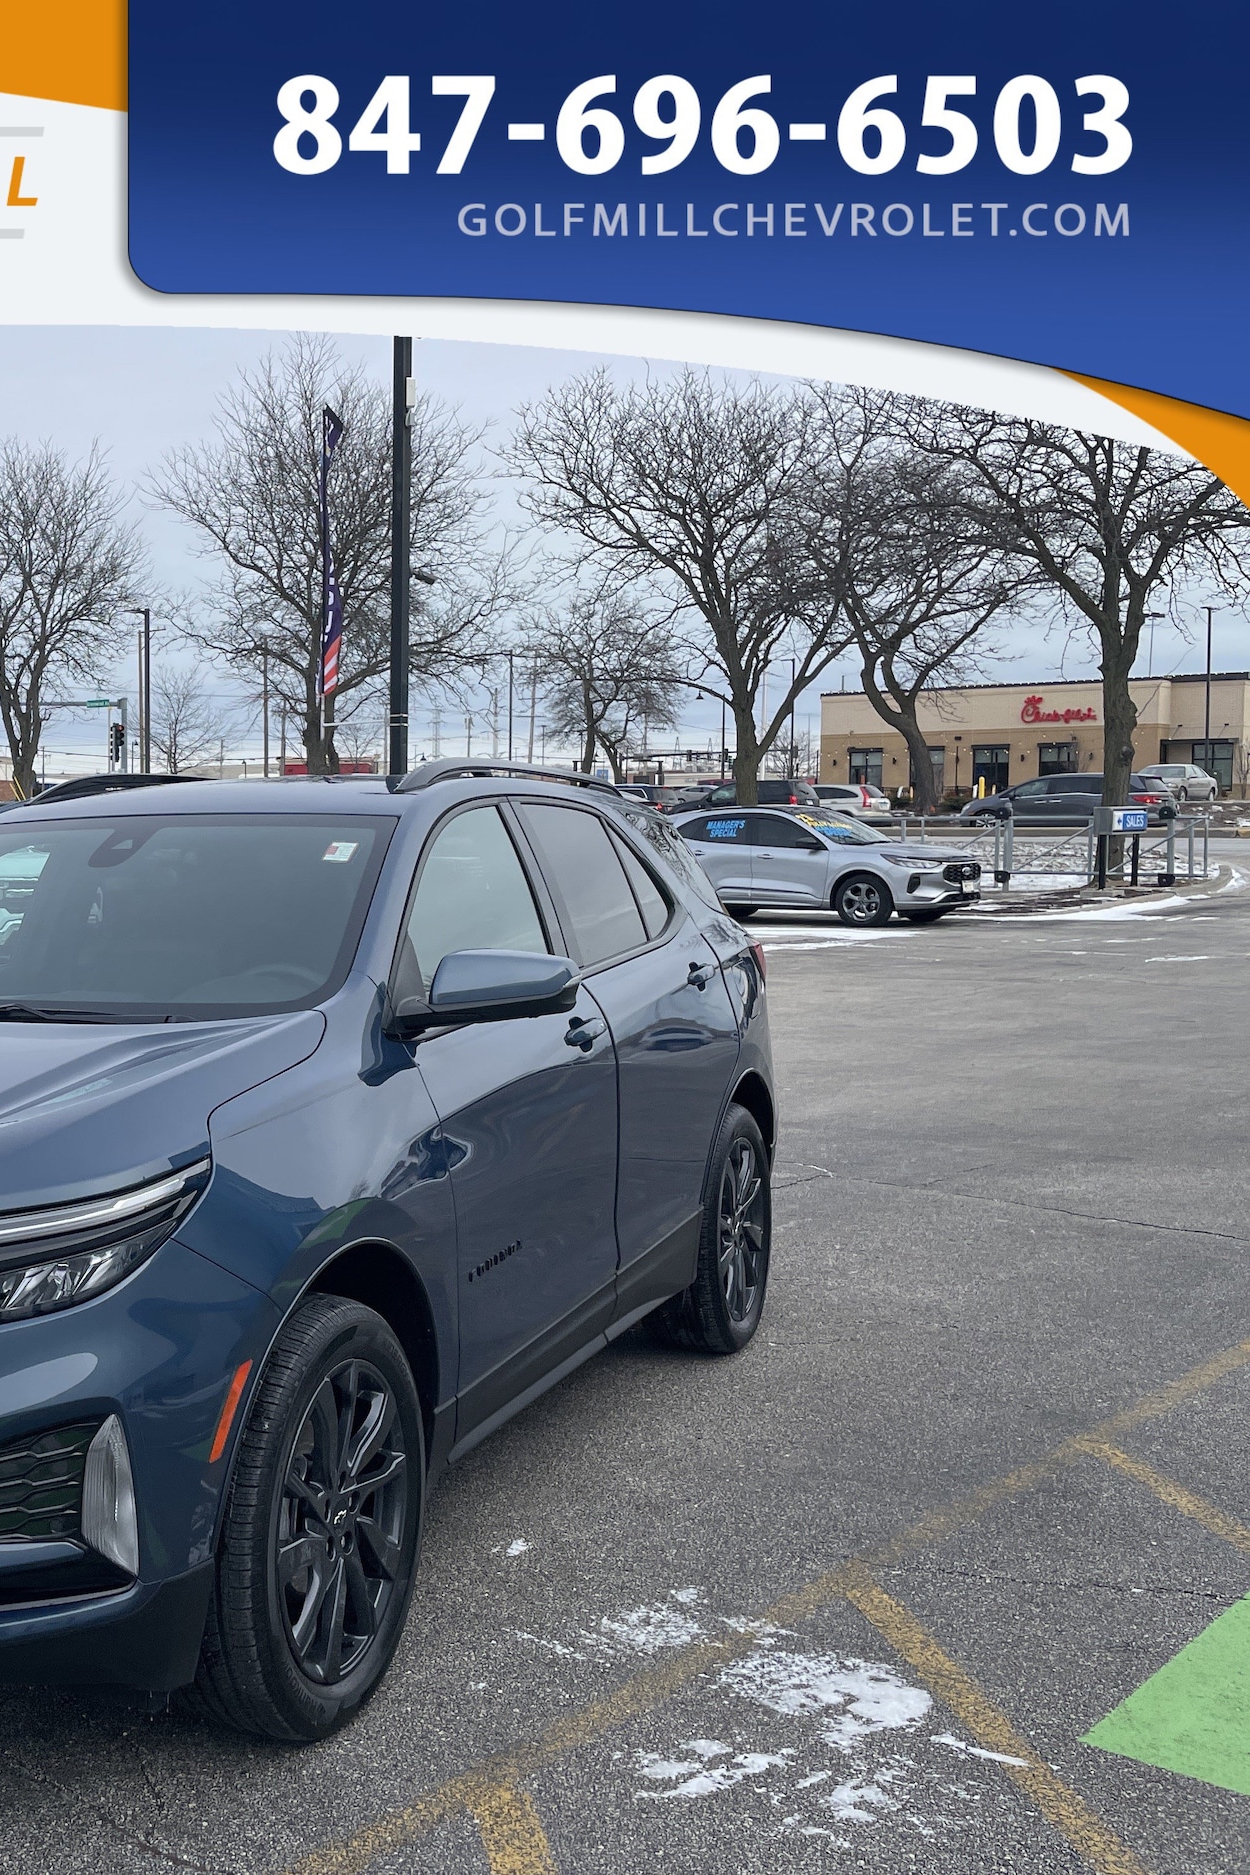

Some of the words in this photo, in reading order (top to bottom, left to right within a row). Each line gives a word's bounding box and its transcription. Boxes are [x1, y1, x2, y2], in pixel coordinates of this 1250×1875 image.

[706, 819, 746, 830] MANAGER'S
[1126, 815, 1144, 828] SALES
[709, 828, 737, 838] SPECIAL
